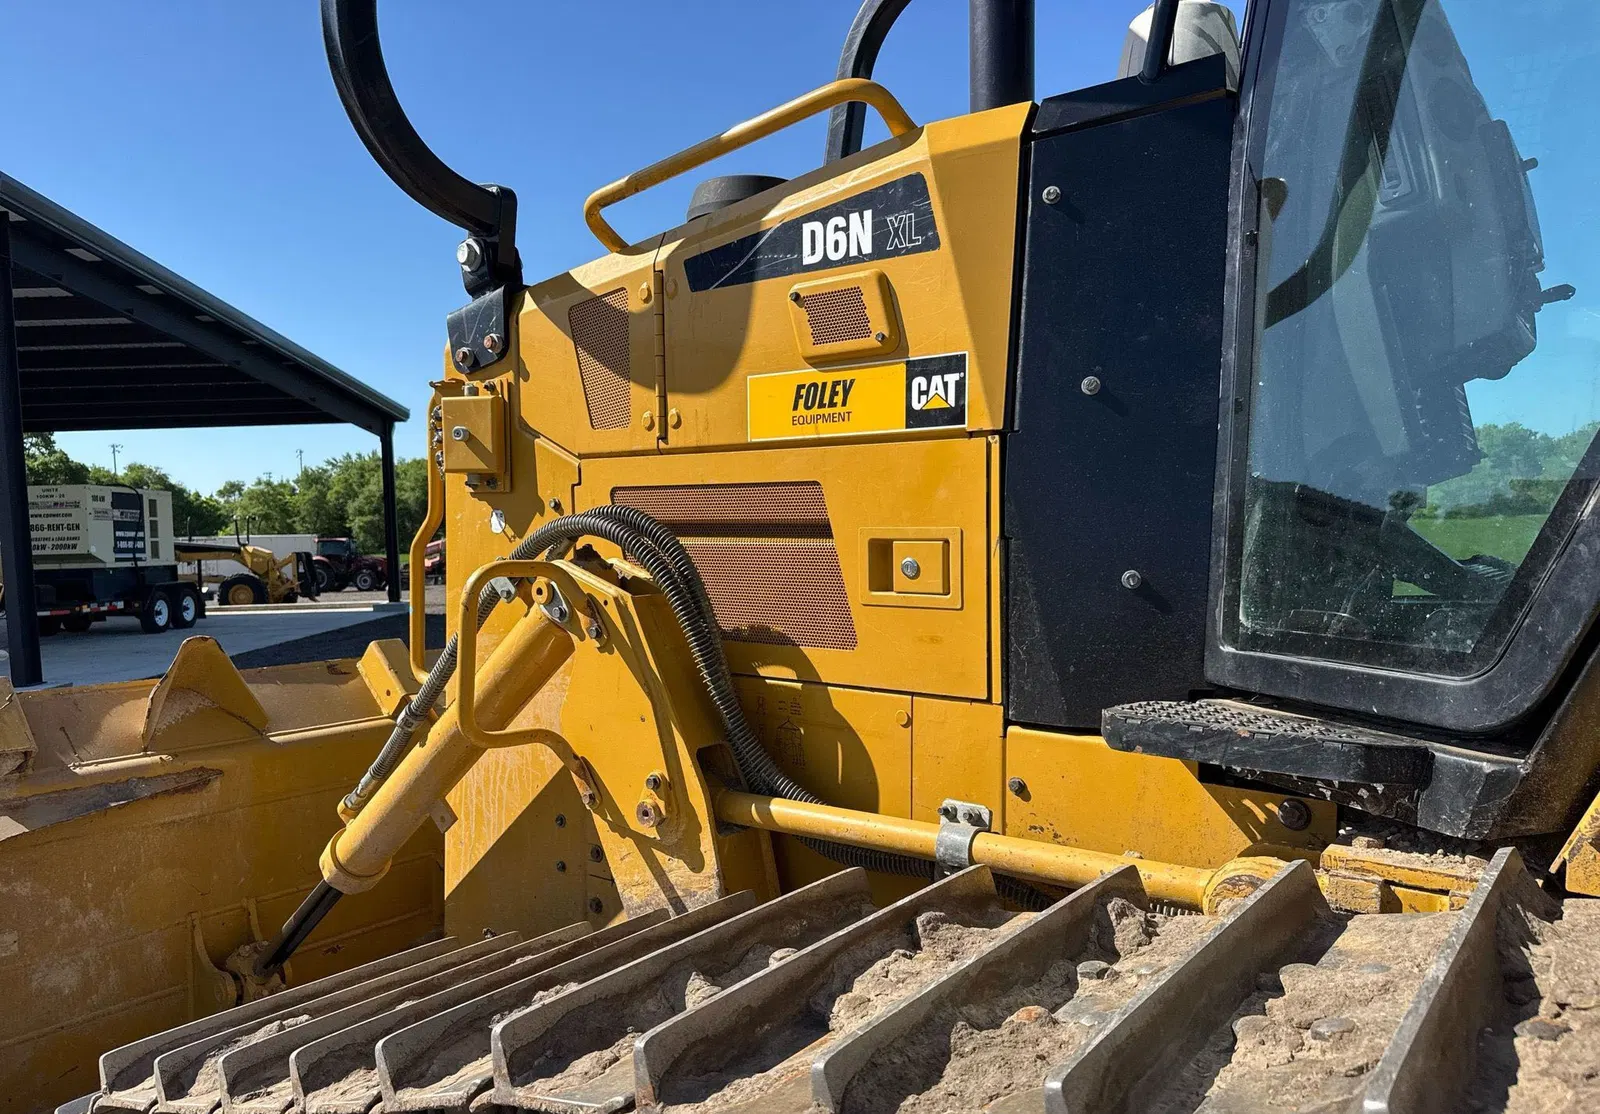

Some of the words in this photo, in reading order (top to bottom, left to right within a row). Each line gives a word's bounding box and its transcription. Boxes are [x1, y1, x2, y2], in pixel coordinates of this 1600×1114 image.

[802, 209, 873, 266] D6N
[886, 212, 923, 251] XL
[791, 378, 856, 412] FOLEY
[911, 372, 960, 411] CAT
[791, 411, 853, 426] EQUIPMENT
